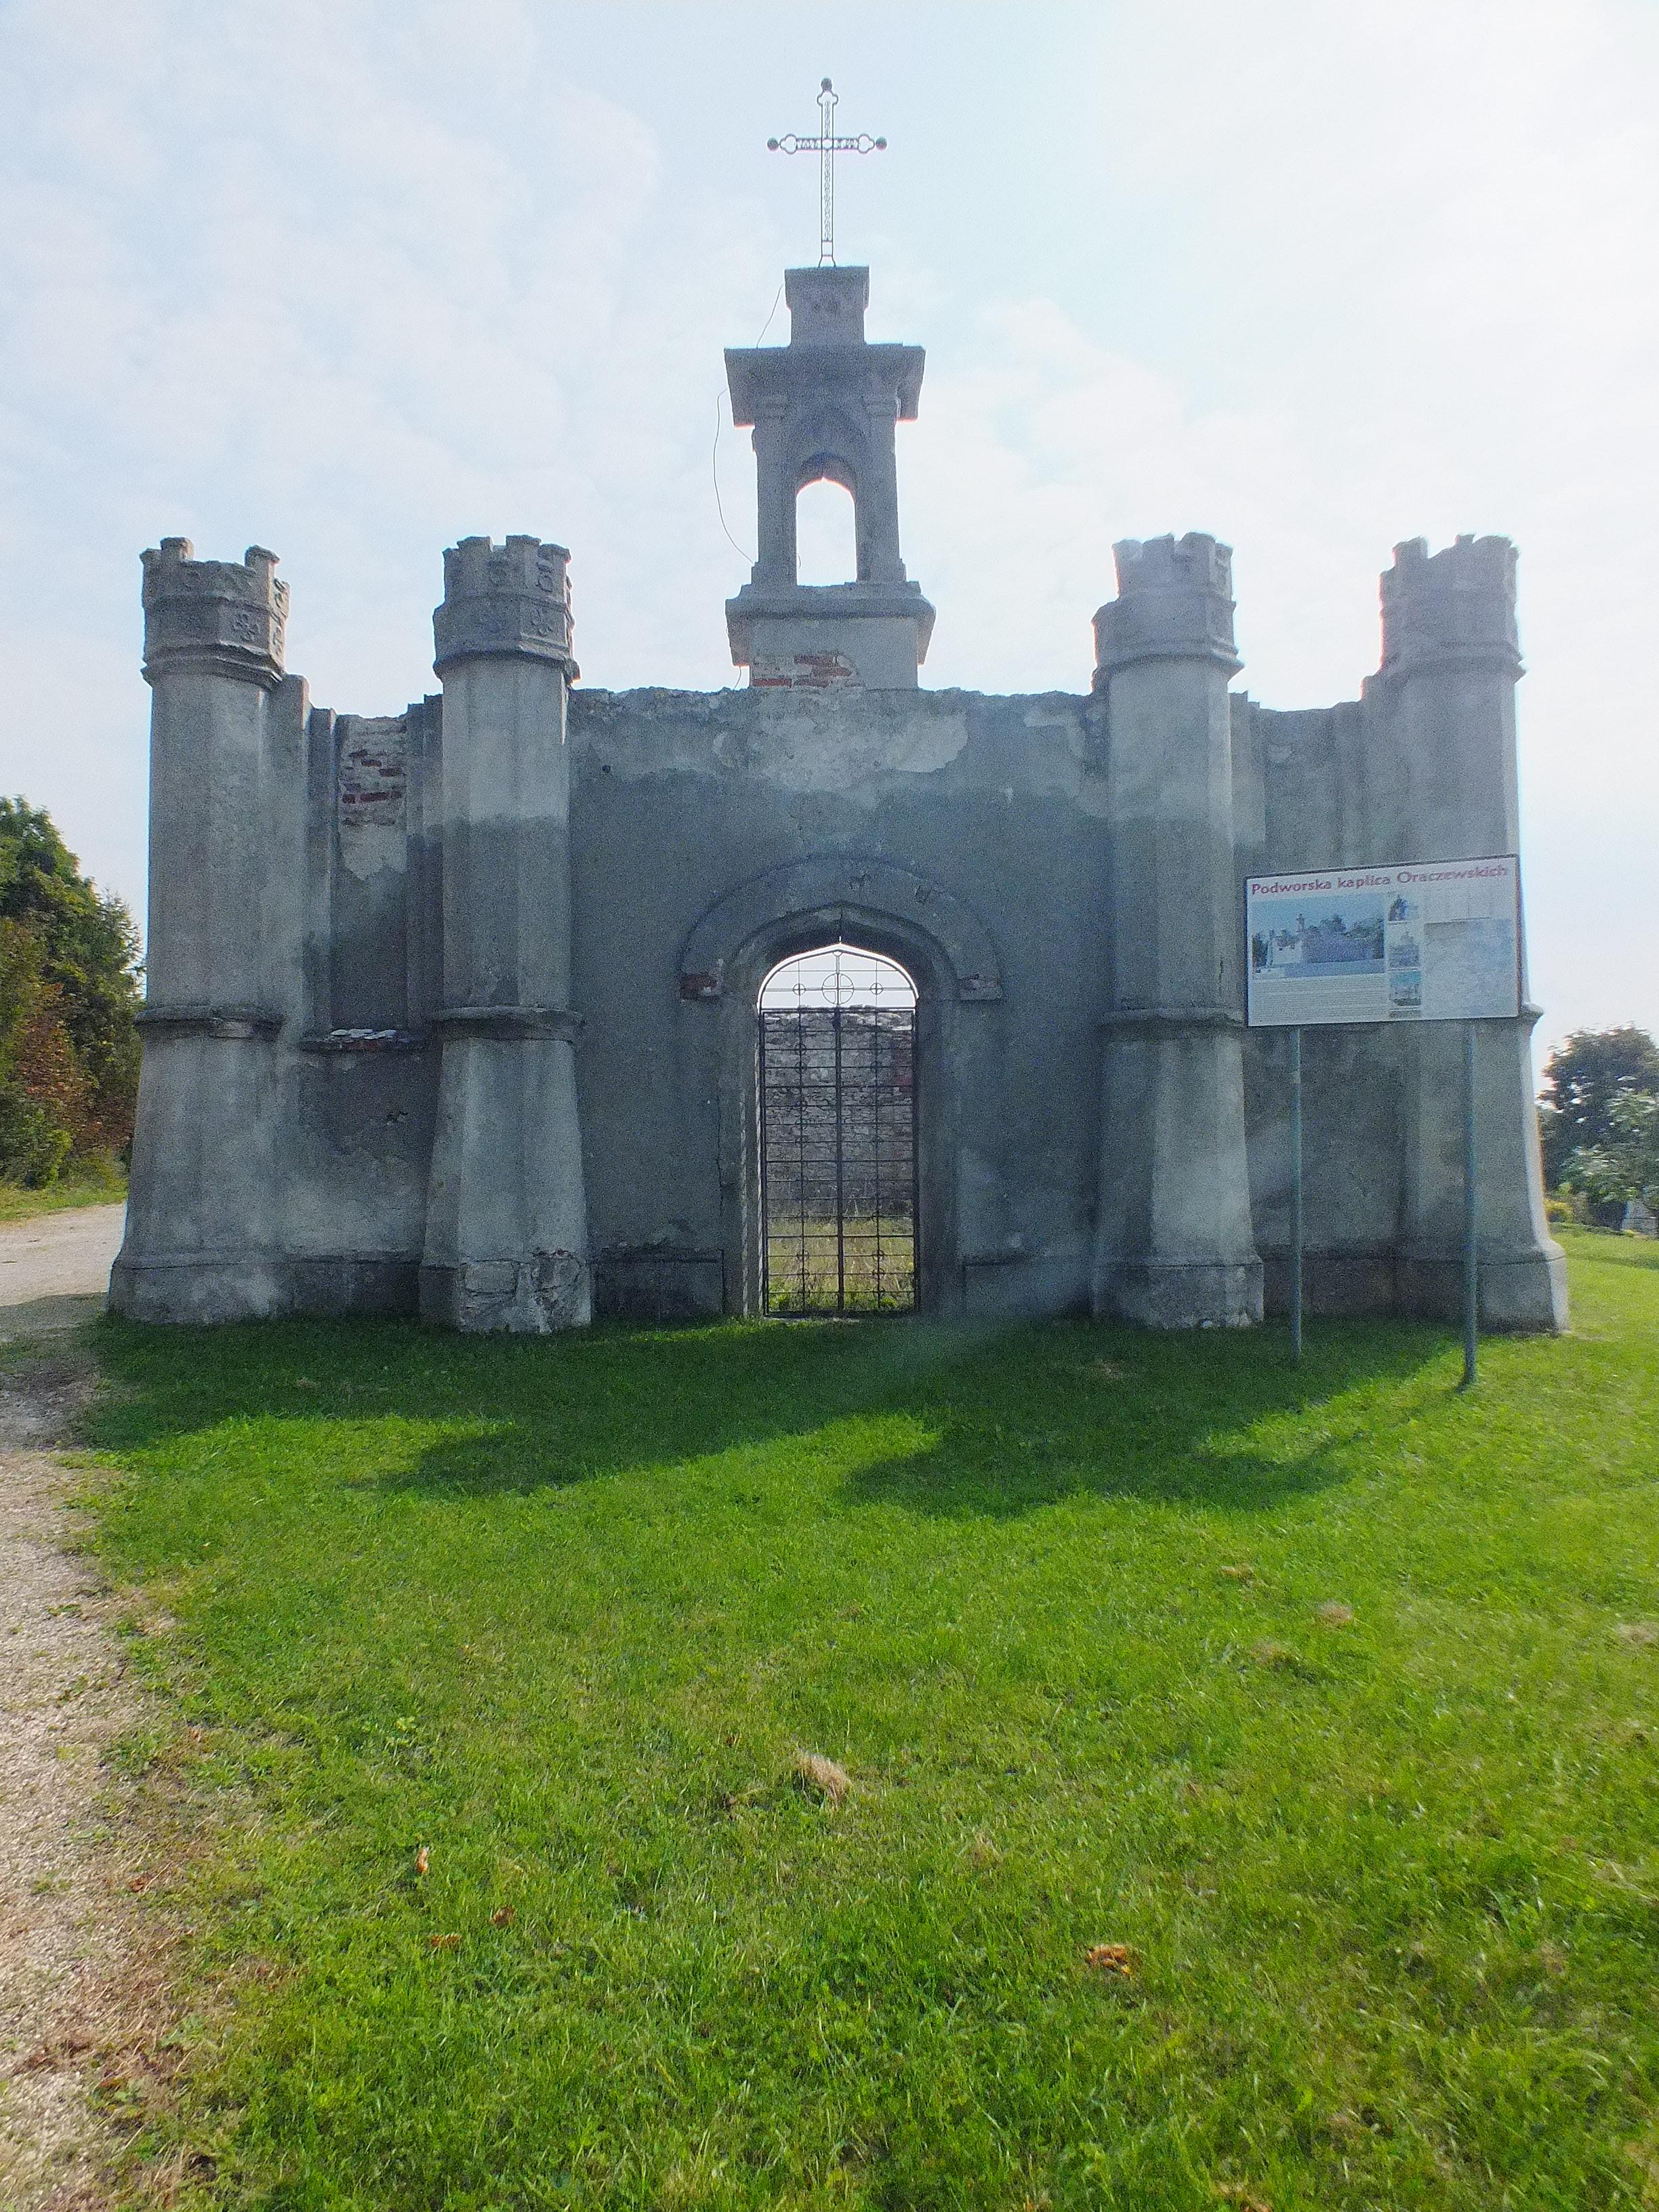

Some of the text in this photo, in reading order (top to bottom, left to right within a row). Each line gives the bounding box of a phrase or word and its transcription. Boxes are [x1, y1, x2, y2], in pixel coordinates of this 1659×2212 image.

[1251, 865, 1508, 895] Podworska kaplica Oraczewskich
